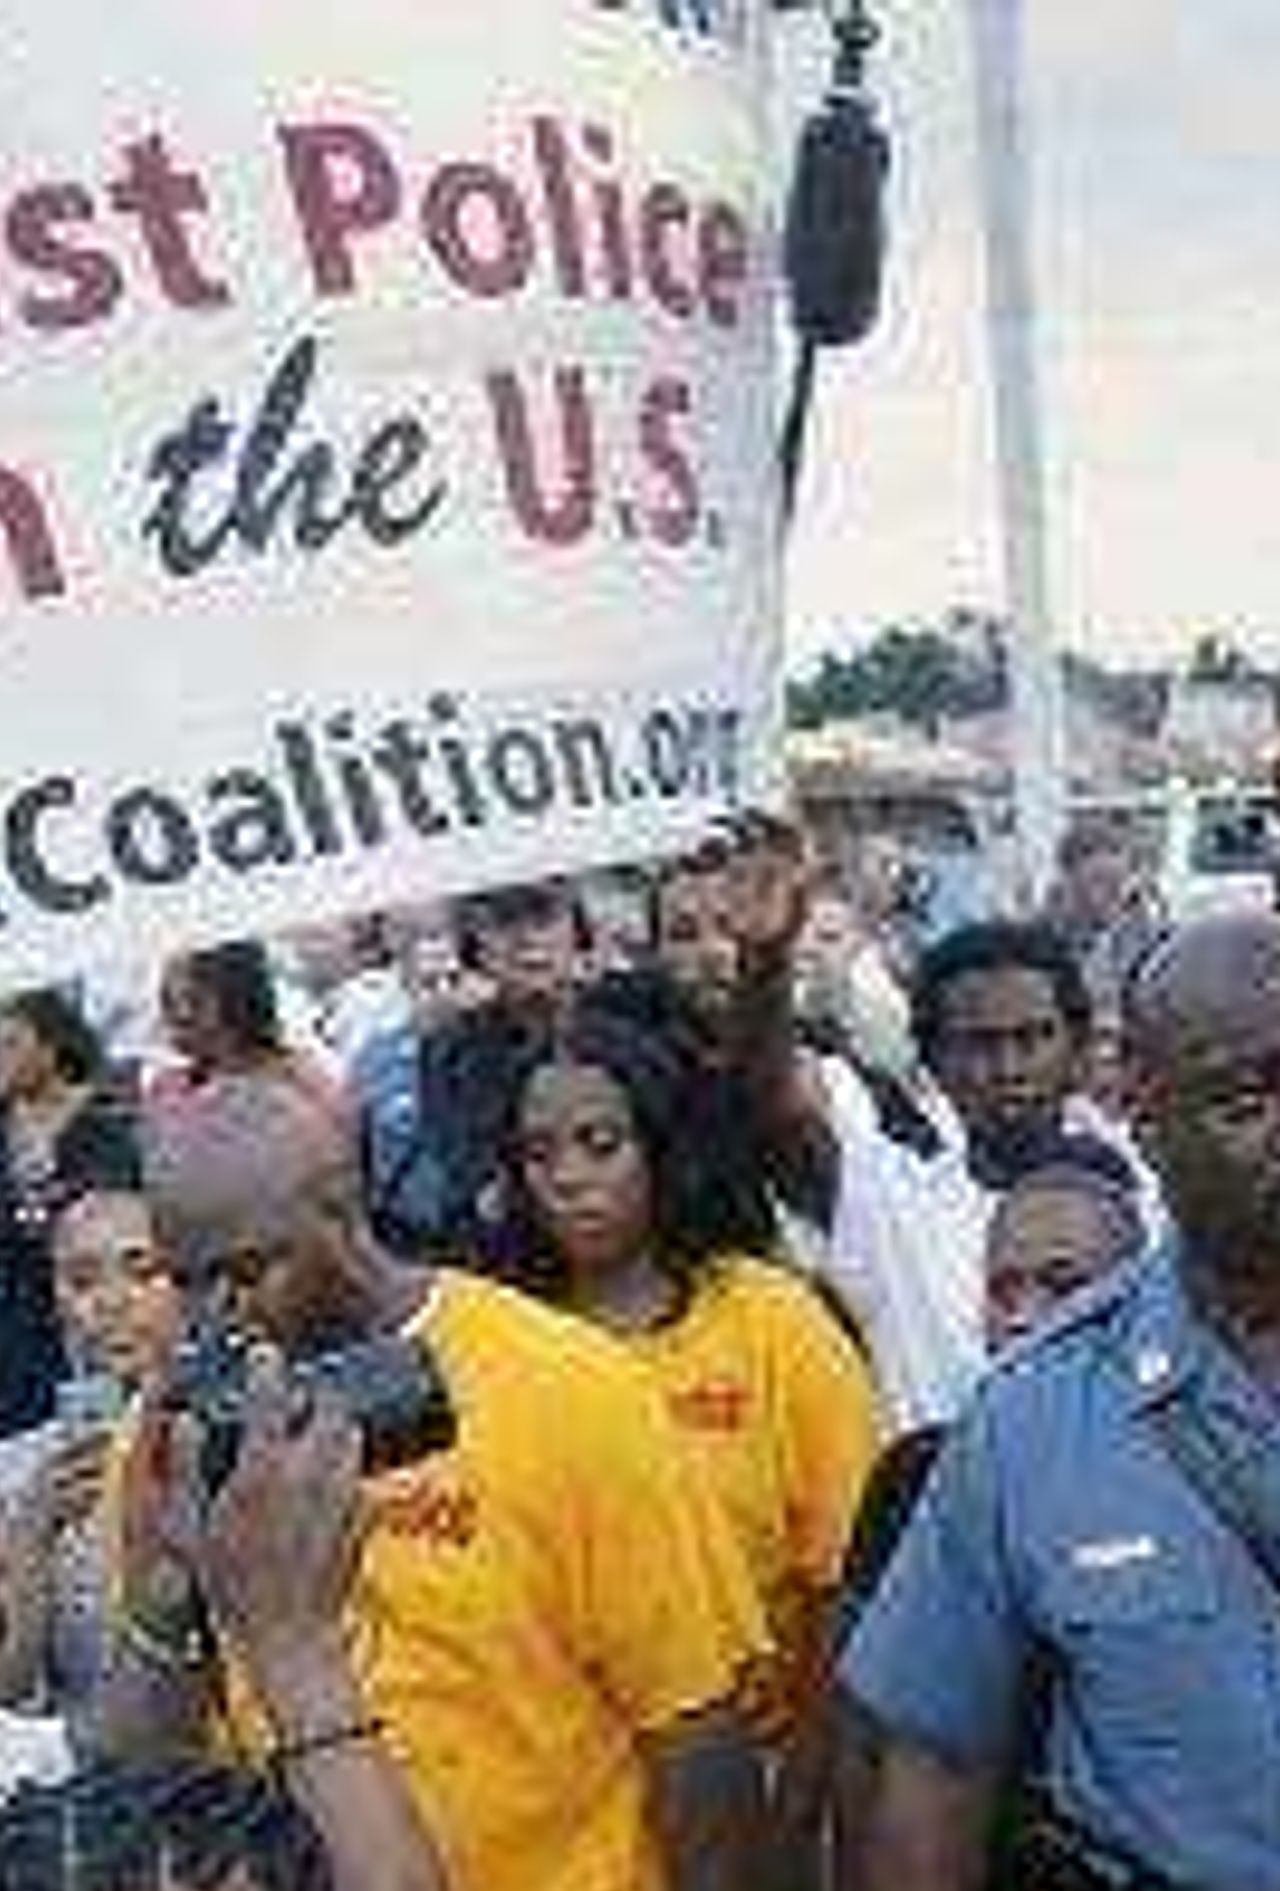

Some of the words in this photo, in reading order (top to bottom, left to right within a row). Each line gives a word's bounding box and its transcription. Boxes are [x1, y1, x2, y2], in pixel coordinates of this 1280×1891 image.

[276, 114, 748, 325] Police
[140, 337, 448, 577] the
[486, 366, 722, 549] U.S.
